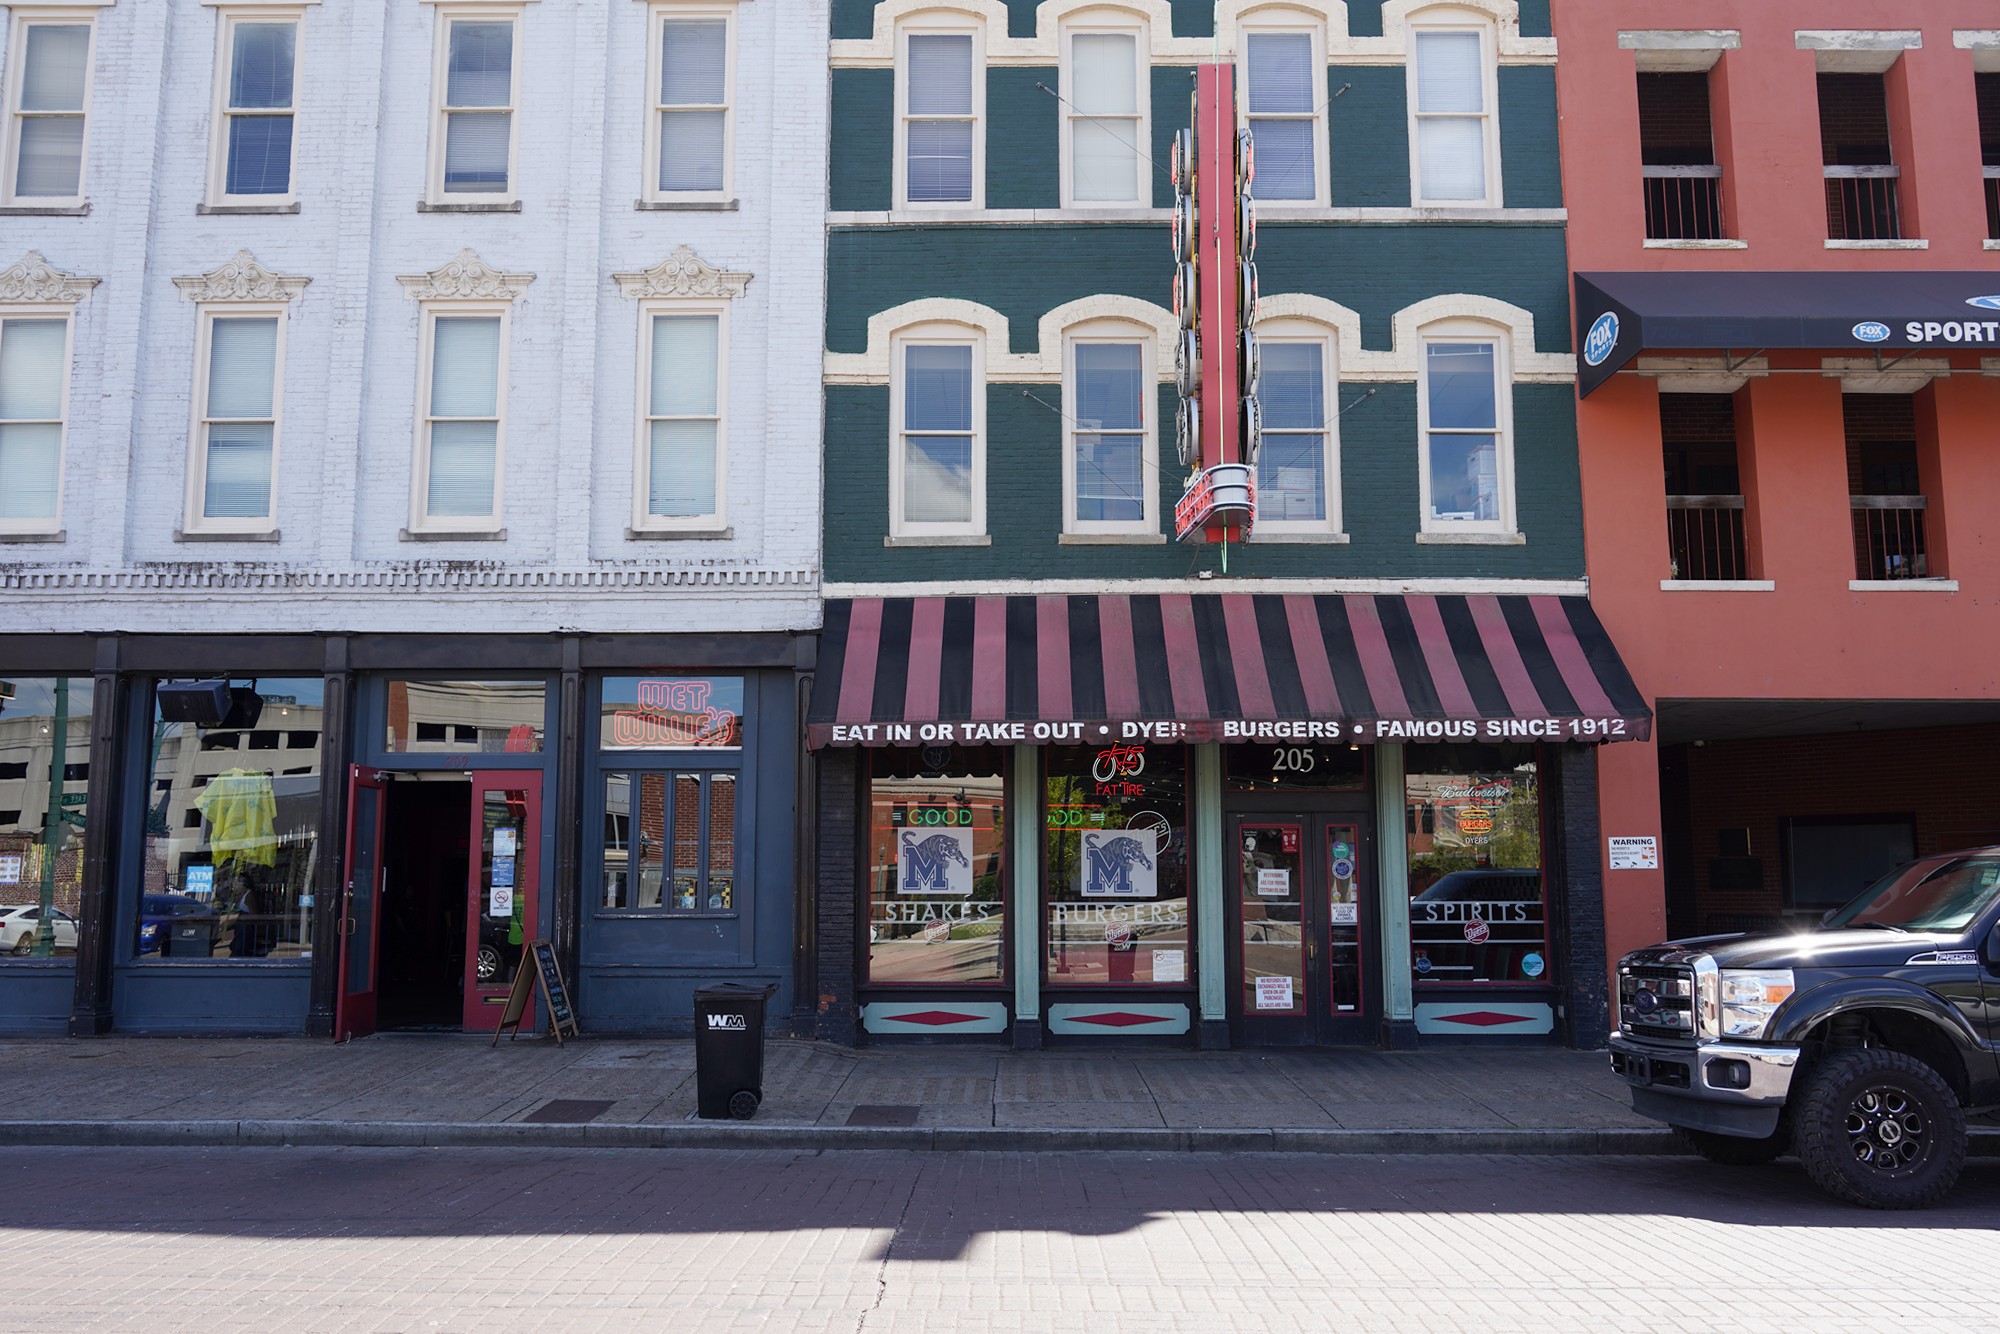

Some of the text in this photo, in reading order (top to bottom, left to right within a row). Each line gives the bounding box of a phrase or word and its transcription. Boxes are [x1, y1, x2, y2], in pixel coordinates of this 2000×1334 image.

[1590, 317, 1613, 353] FOX
[1860, 325, 1883, 335] FOX
[1905, 321, 2000, 342] SPORT
[640, 684, 707, 711] WET
[617, 707, 733, 742] WILLIE'S
[832, 724, 878, 741] EAT
[886, 724, 912, 741] IN
[919, 723, 954, 741] OR
[961, 722, 1026, 740] TAKE
[1033, 722, 1085, 739] OUT
[1223, 720, 1340, 738] BURGERS
[1376, 720, 1477, 738] FAMOUS
[1486, 718, 1561, 737] SINCE
[1568, 718, 1626, 736] 1912
[445, 755, 468, 768] 209
[1272, 748, 1315, 773] 205
[1095, 781, 1144, 796] FAT TIRE
[1438, 784, 1509, 799] Budweiser
[909, 809, 973, 825] GOOD
[1460, 819, 1493, 829] BURGERS
[1465, 836, 1489, 845] DYERS
[187, 871, 213, 880] ATM
[885, 903, 989, 922] SHAKES
[1056, 904, 1180, 922] BURGERS
[1426, 903, 1527, 921] SPIRITS
[707, 1014, 746, 1027] WM
